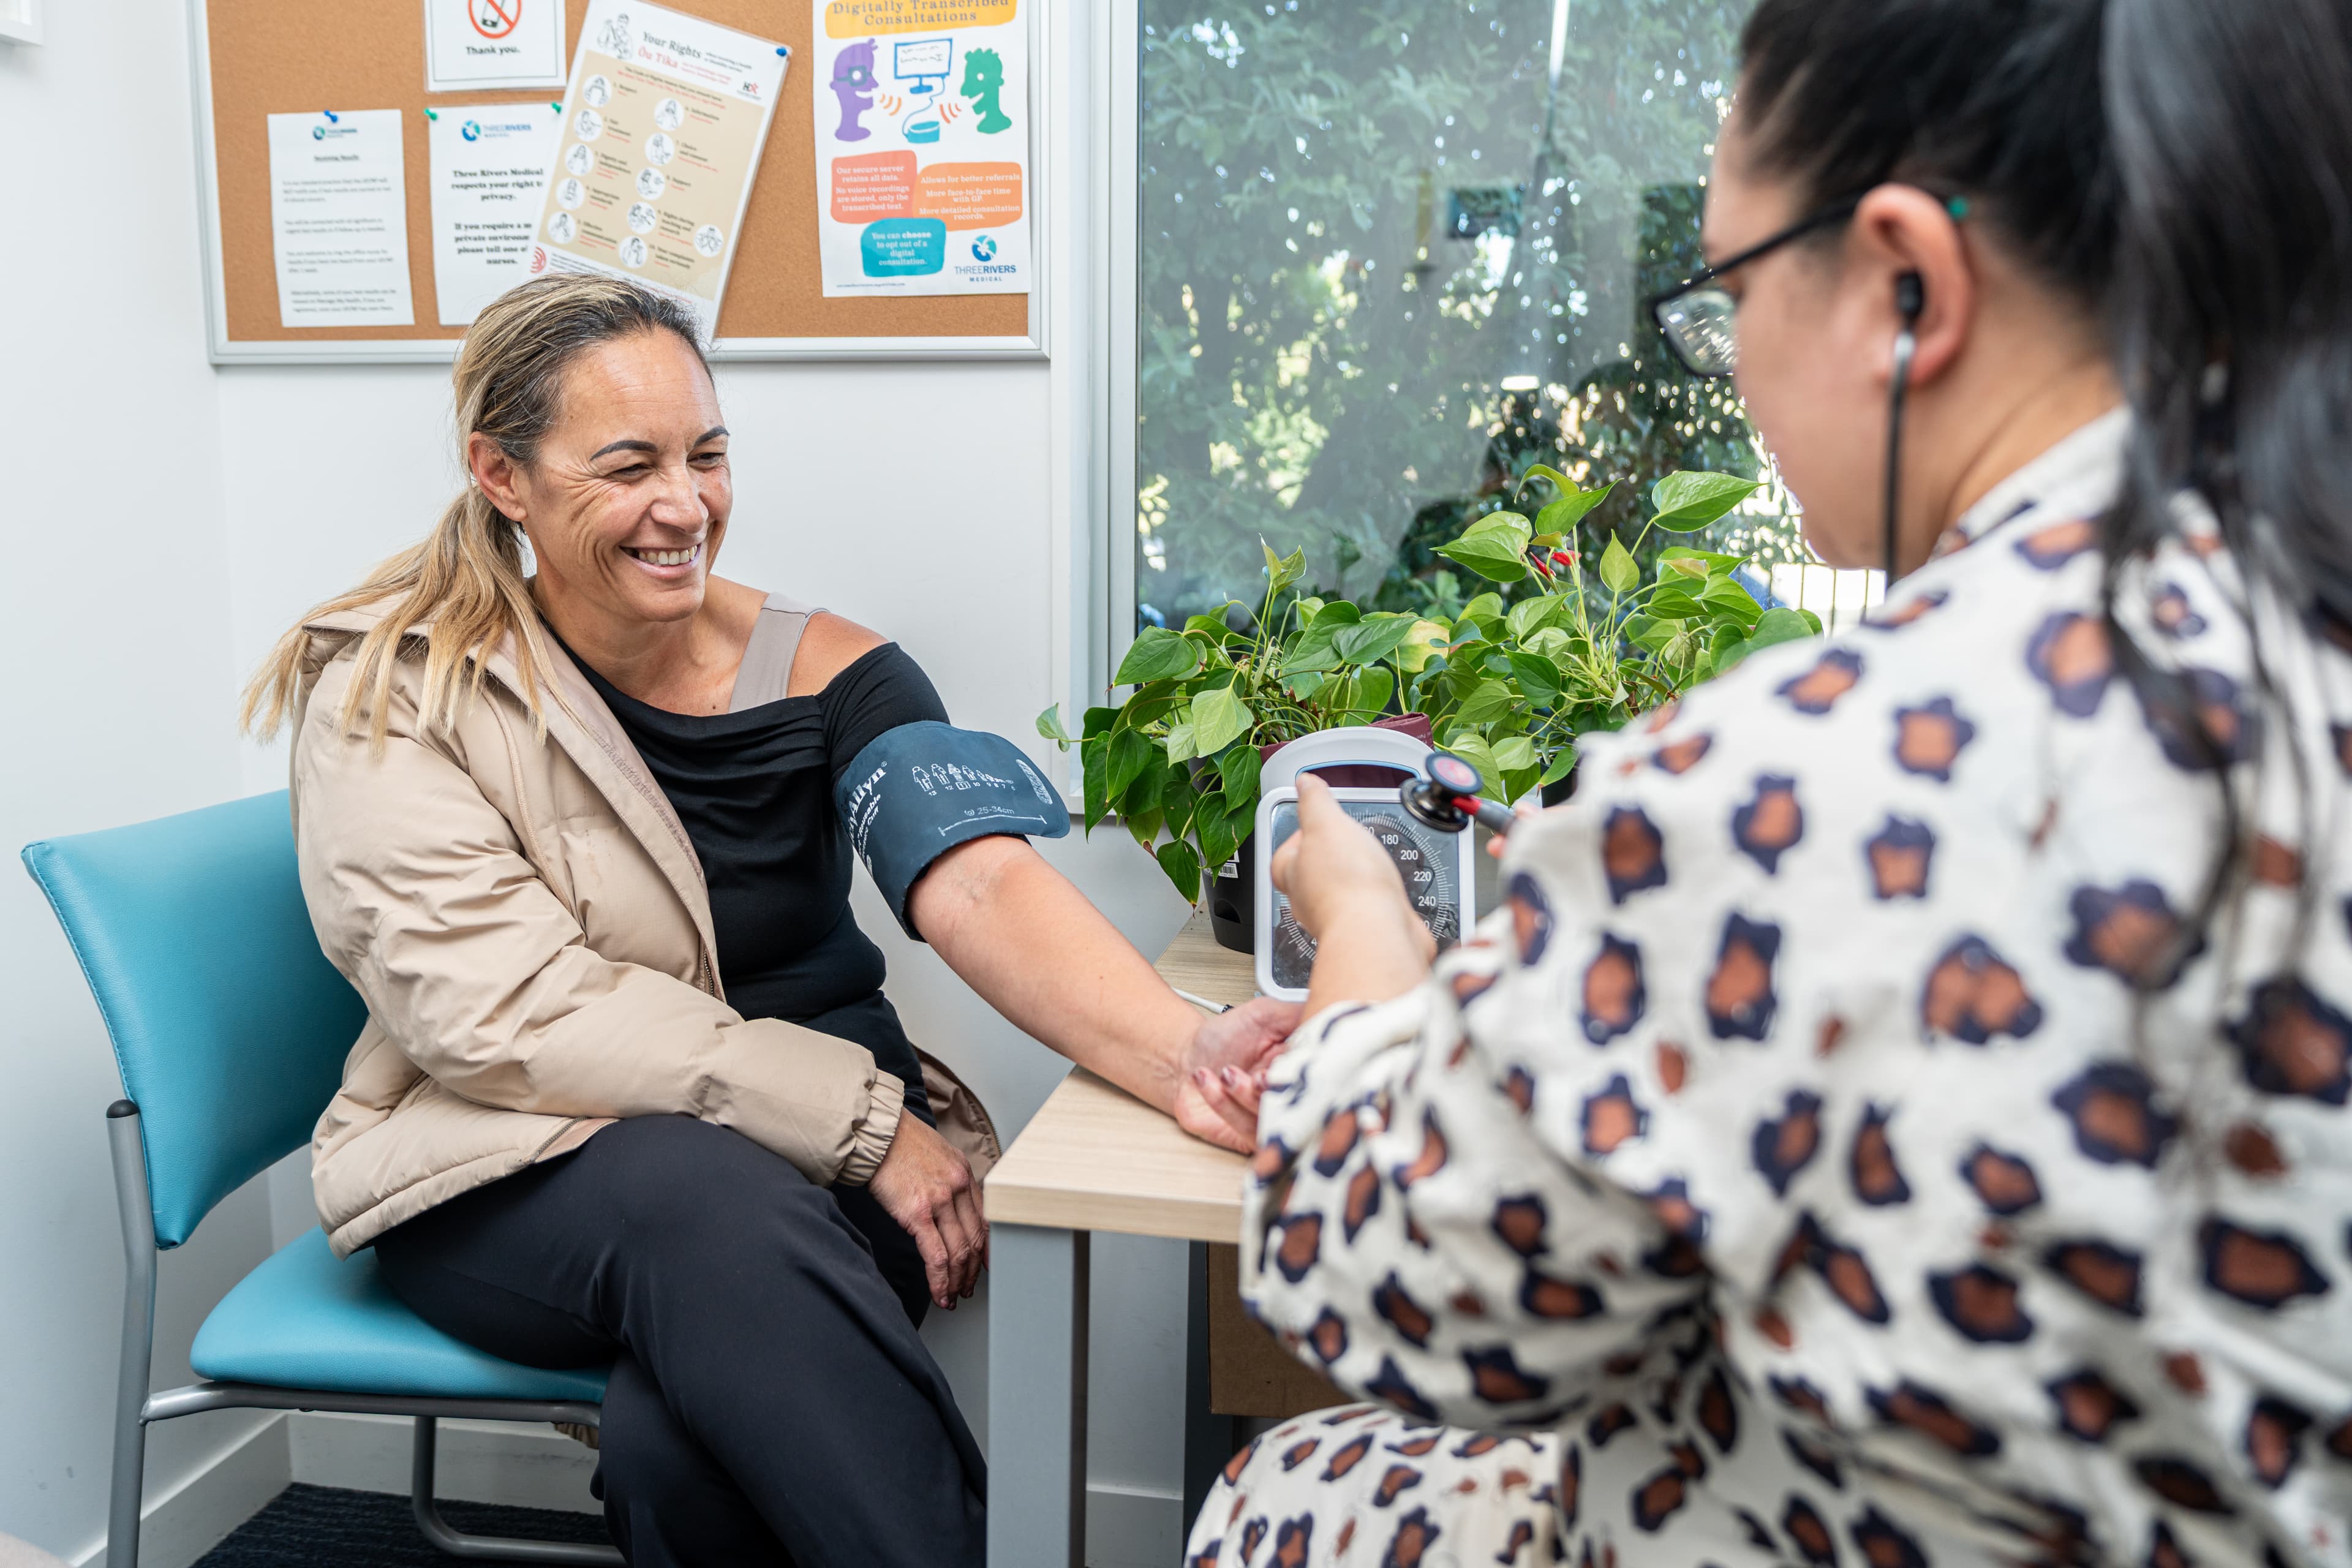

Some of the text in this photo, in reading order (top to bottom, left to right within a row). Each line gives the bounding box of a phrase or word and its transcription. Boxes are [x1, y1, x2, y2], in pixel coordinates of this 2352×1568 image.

[833, 0, 1009, 15] Digitally Transcribed
[864, 12, 977, 26] Consultations
[466, 45, 521, 55] Thank you.
[643, 32, 701, 58] Your Rights
[481, 193, 516, 202] privacy.
[482, 222, 514, 231] require
[455, 234, 485, 243] private
[458, 246, 484, 255] please
[886, 241, 898, 250] opt
[890, 249, 914, 258] digital
[978, 805, 1015, 815] 25-34cm
[867, 805, 880, 826] Cuff
[1381, 834, 1399, 845] 180
[1400, 850, 1419, 861] 200
[1414, 871, 1431, 882] 220
[1418, 895, 1436, 907] 240
